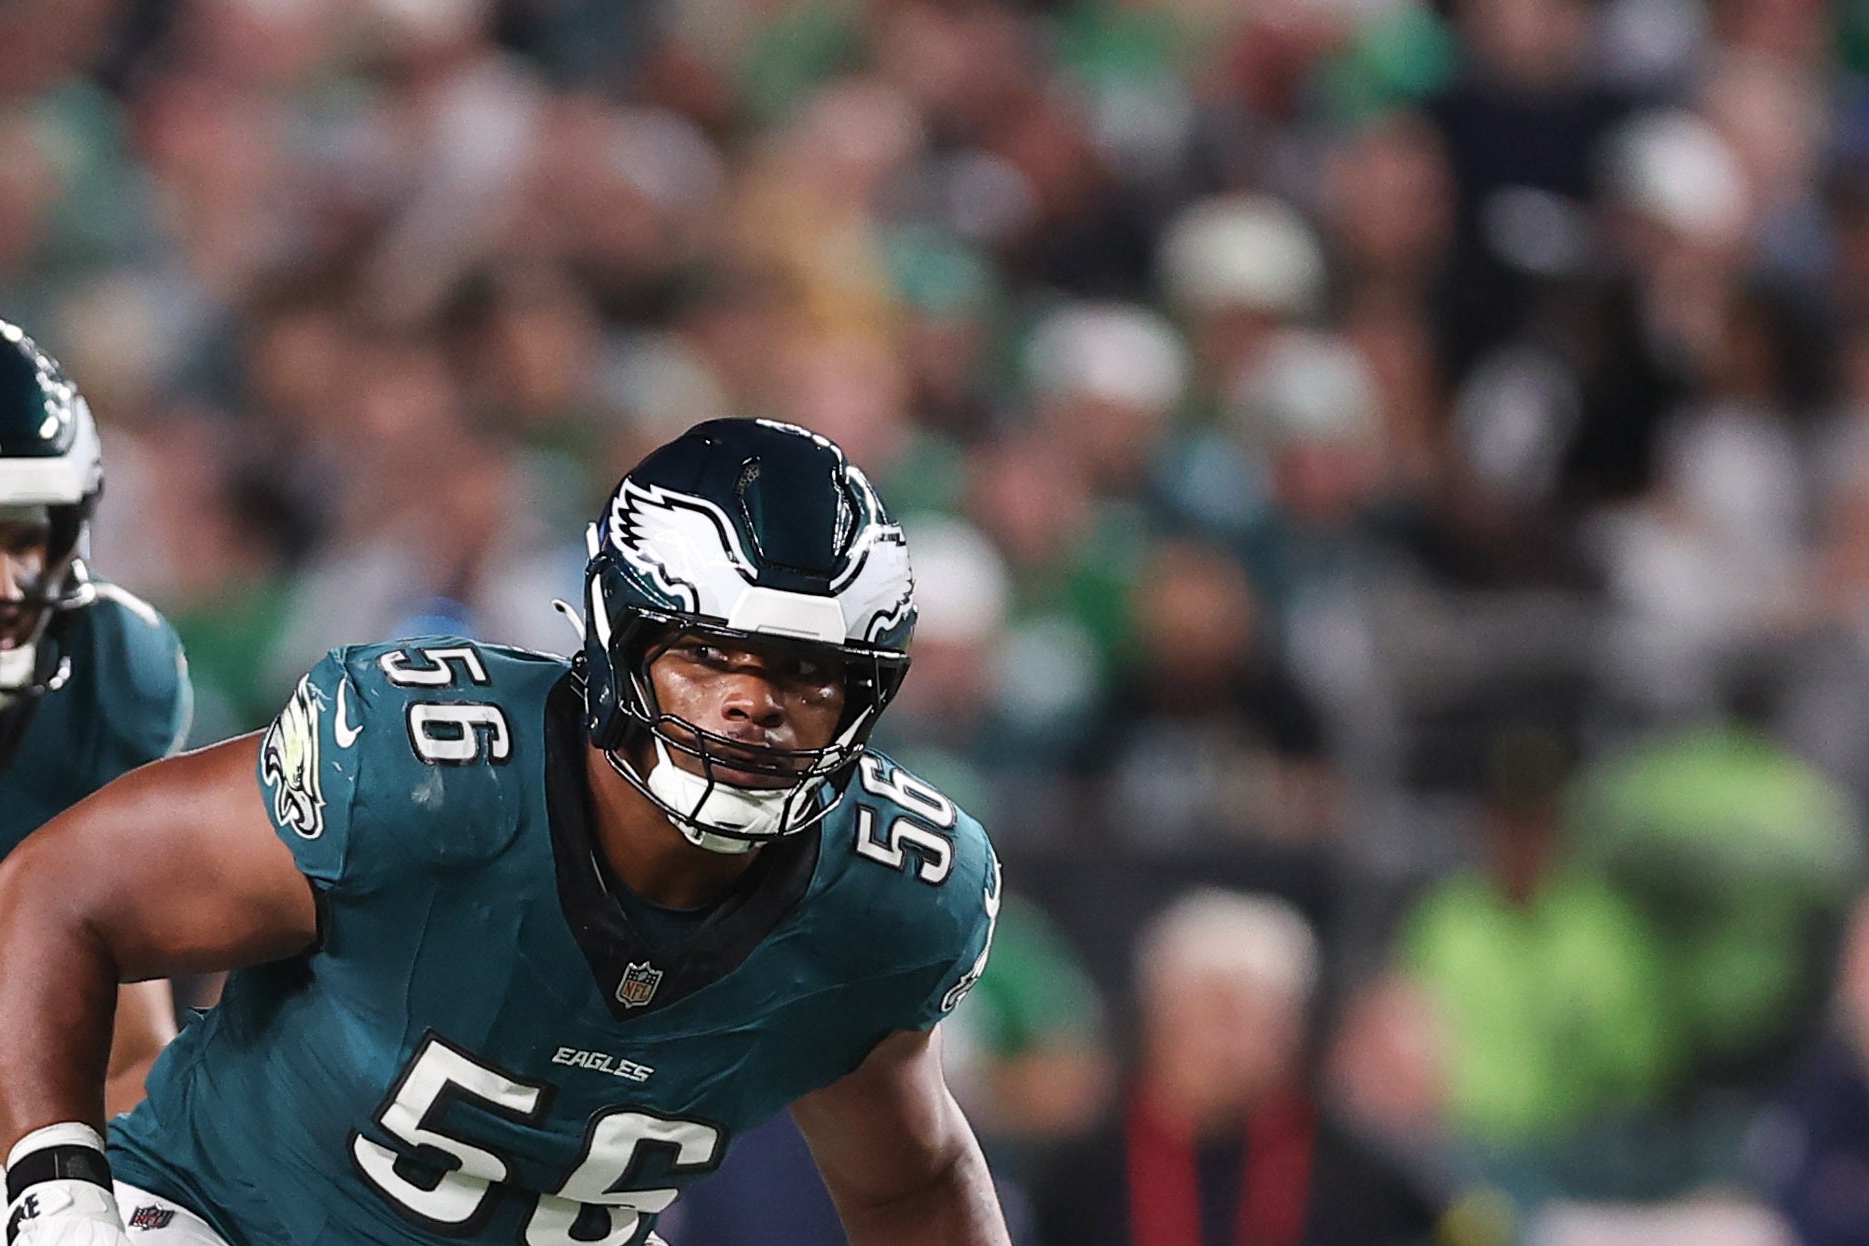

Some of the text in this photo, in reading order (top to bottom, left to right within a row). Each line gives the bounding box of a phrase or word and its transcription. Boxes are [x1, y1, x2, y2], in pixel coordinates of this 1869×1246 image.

[378, 646, 512, 763] 56
[855, 752, 956, 885] 56
[625, 981, 649, 1000] NFL
[552, 1047, 655, 1082] EAGLES
